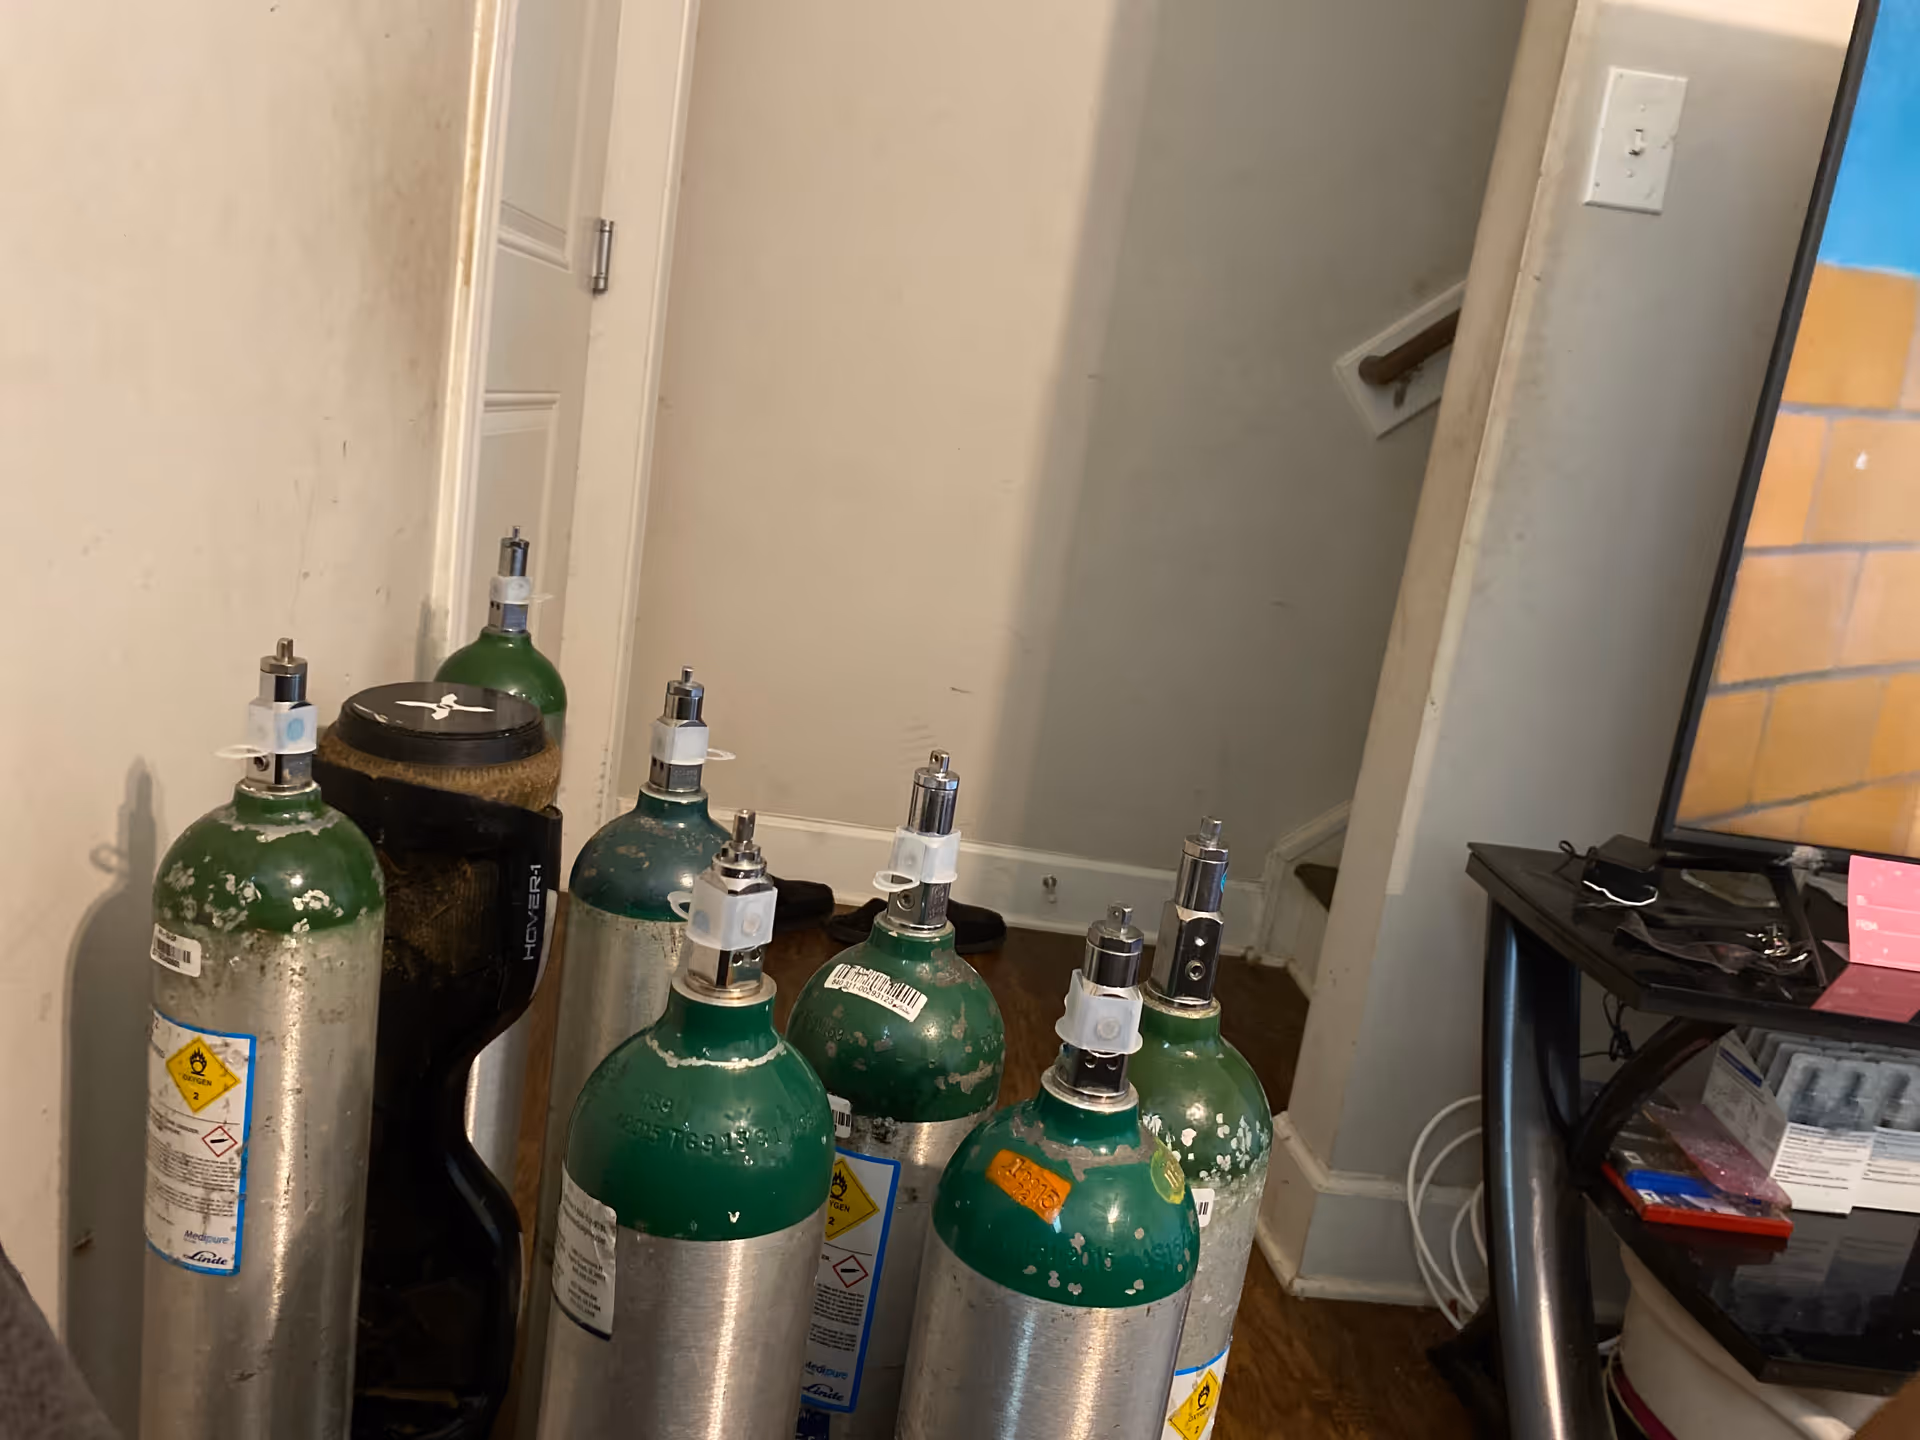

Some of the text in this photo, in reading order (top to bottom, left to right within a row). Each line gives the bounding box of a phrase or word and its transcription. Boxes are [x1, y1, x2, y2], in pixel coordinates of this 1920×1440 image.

[523, 864, 541, 960] HOVER-1
[182, 1073, 212, 1087] OXYGEN
[192, 1091, 200, 1101] 2
[830, 1200, 850, 1212] YGEN
[828, 1216, 835, 1226] 2
[184, 1229, 230, 1244] Medipure
[182, 1250, 228, 1265] Linde
[802, 1383, 844, 1402] Linde
